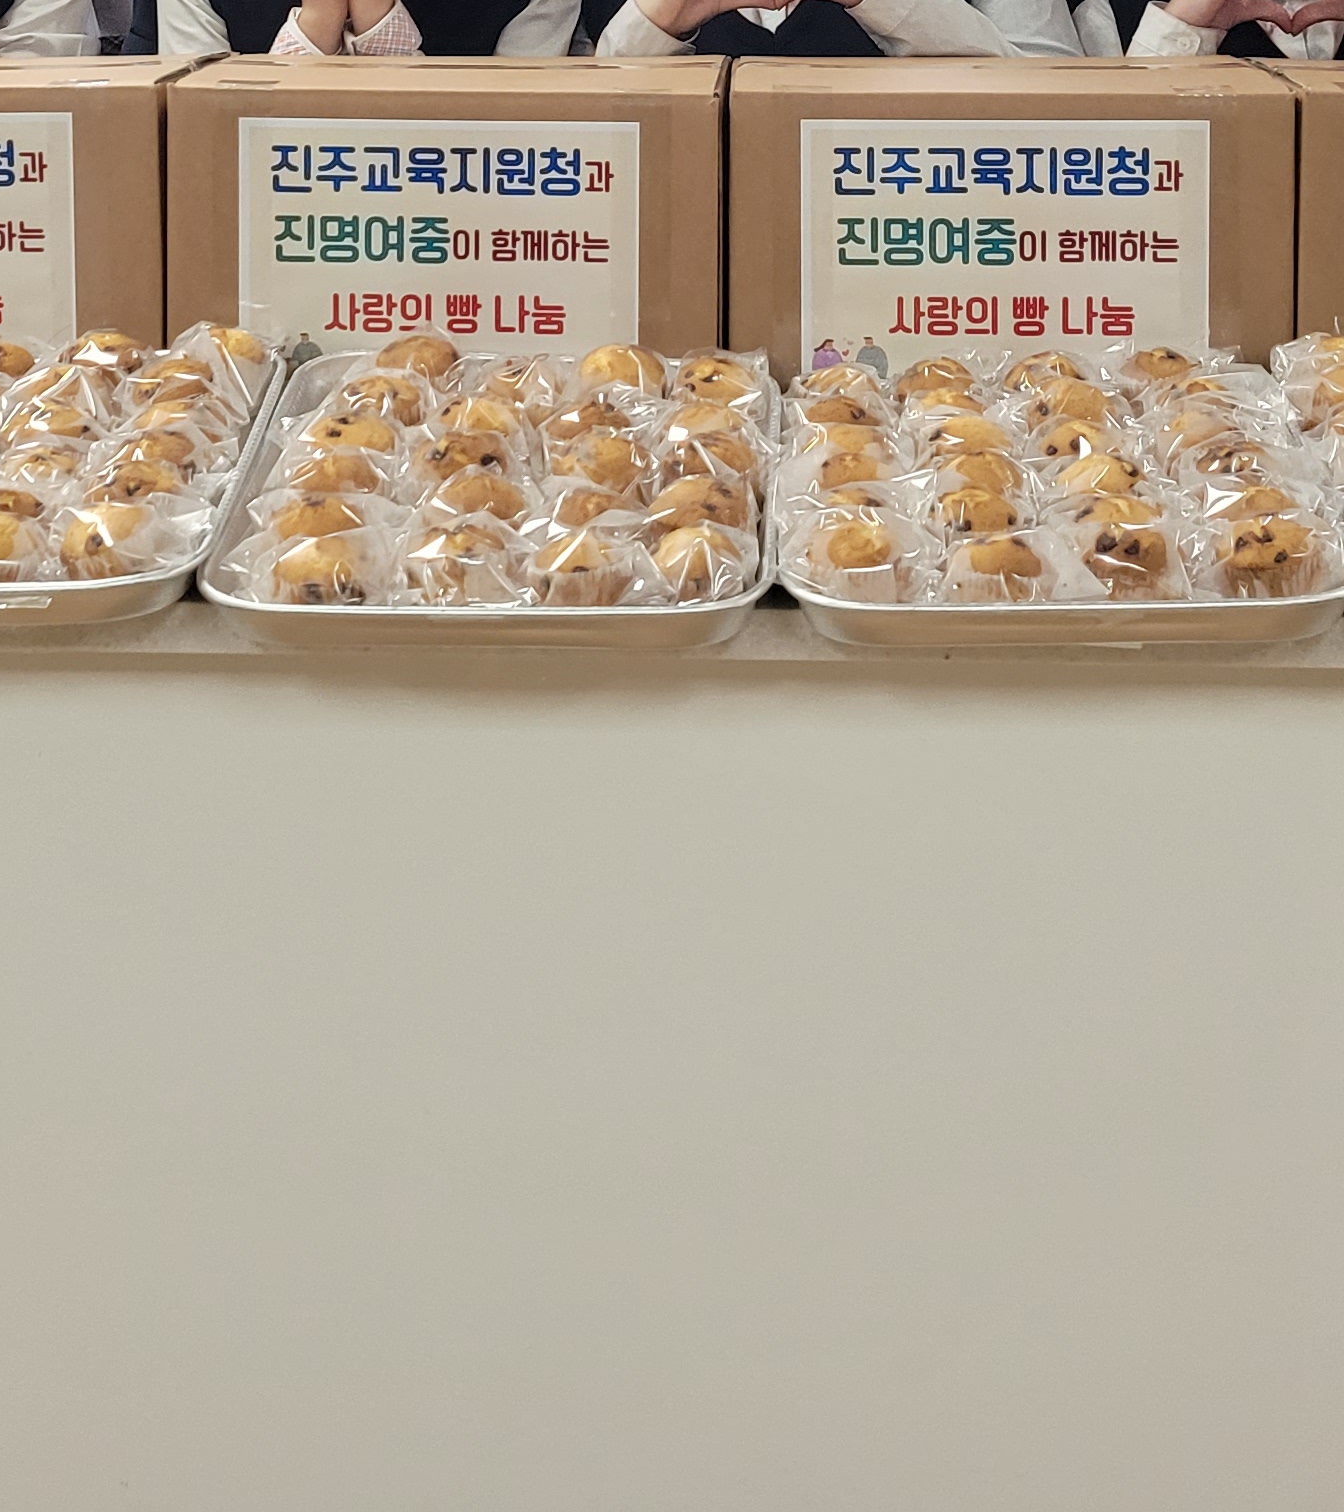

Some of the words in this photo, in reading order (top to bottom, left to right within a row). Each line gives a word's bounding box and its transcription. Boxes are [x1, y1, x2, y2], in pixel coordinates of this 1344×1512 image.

[270, 144, 614, 196] 진주교육지원청과
[833, 145, 1184, 196] 진주교육지원청과
[273, 214, 480, 264] 진명여중이
[491, 228, 610, 263] 함께하는
[837, 217, 1047, 266] 진명여중이
[1058, 229, 1180, 264] 함께하는
[324, 292, 432, 332] 사랑의
[446, 293, 482, 333] 빵
[493, 294, 566, 335] 나눔
[888, 295, 998, 336] 사랑의
[1012, 296, 1049, 336] 빵
[1061, 296, 1136, 337] 나눔
